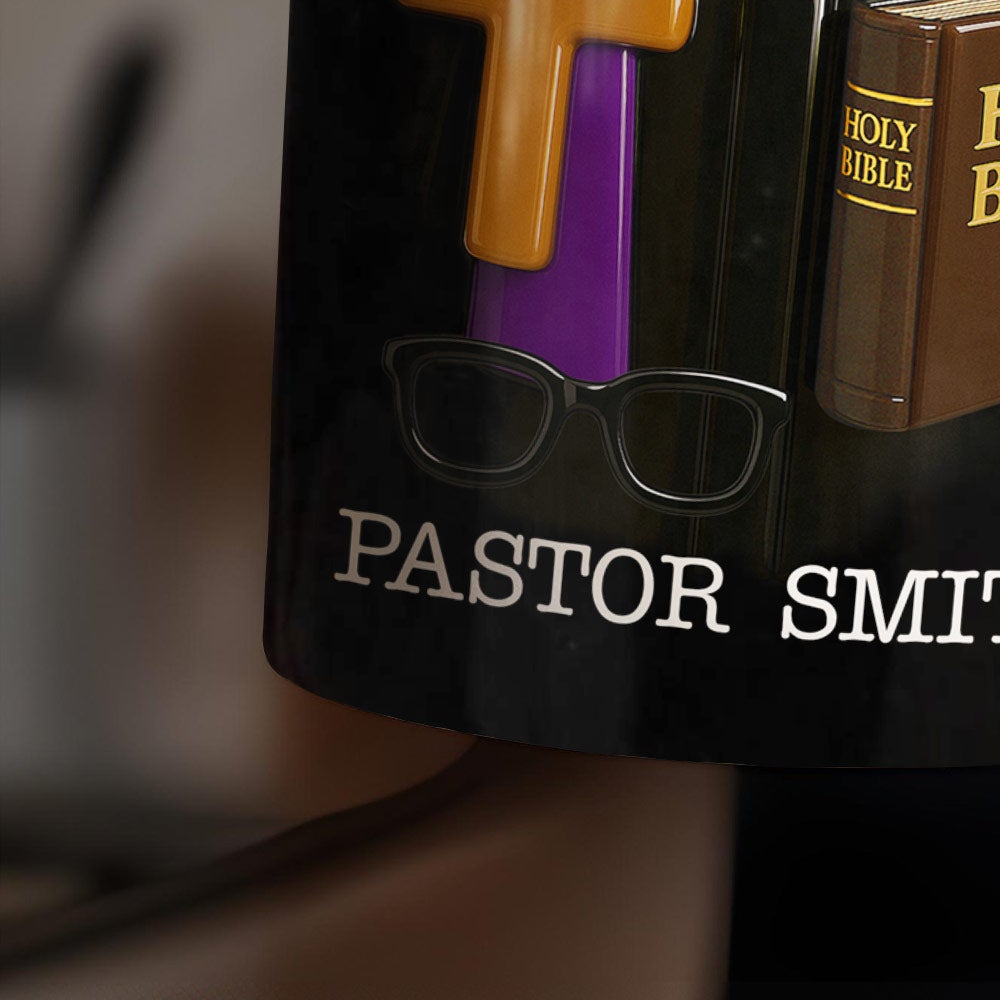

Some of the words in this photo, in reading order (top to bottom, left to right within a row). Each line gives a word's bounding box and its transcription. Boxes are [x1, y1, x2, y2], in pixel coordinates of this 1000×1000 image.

[843, 105, 918, 154] HOLY
[840, 145, 913, 192] BIBLE
[333, 508, 730, 633] PASTOR
